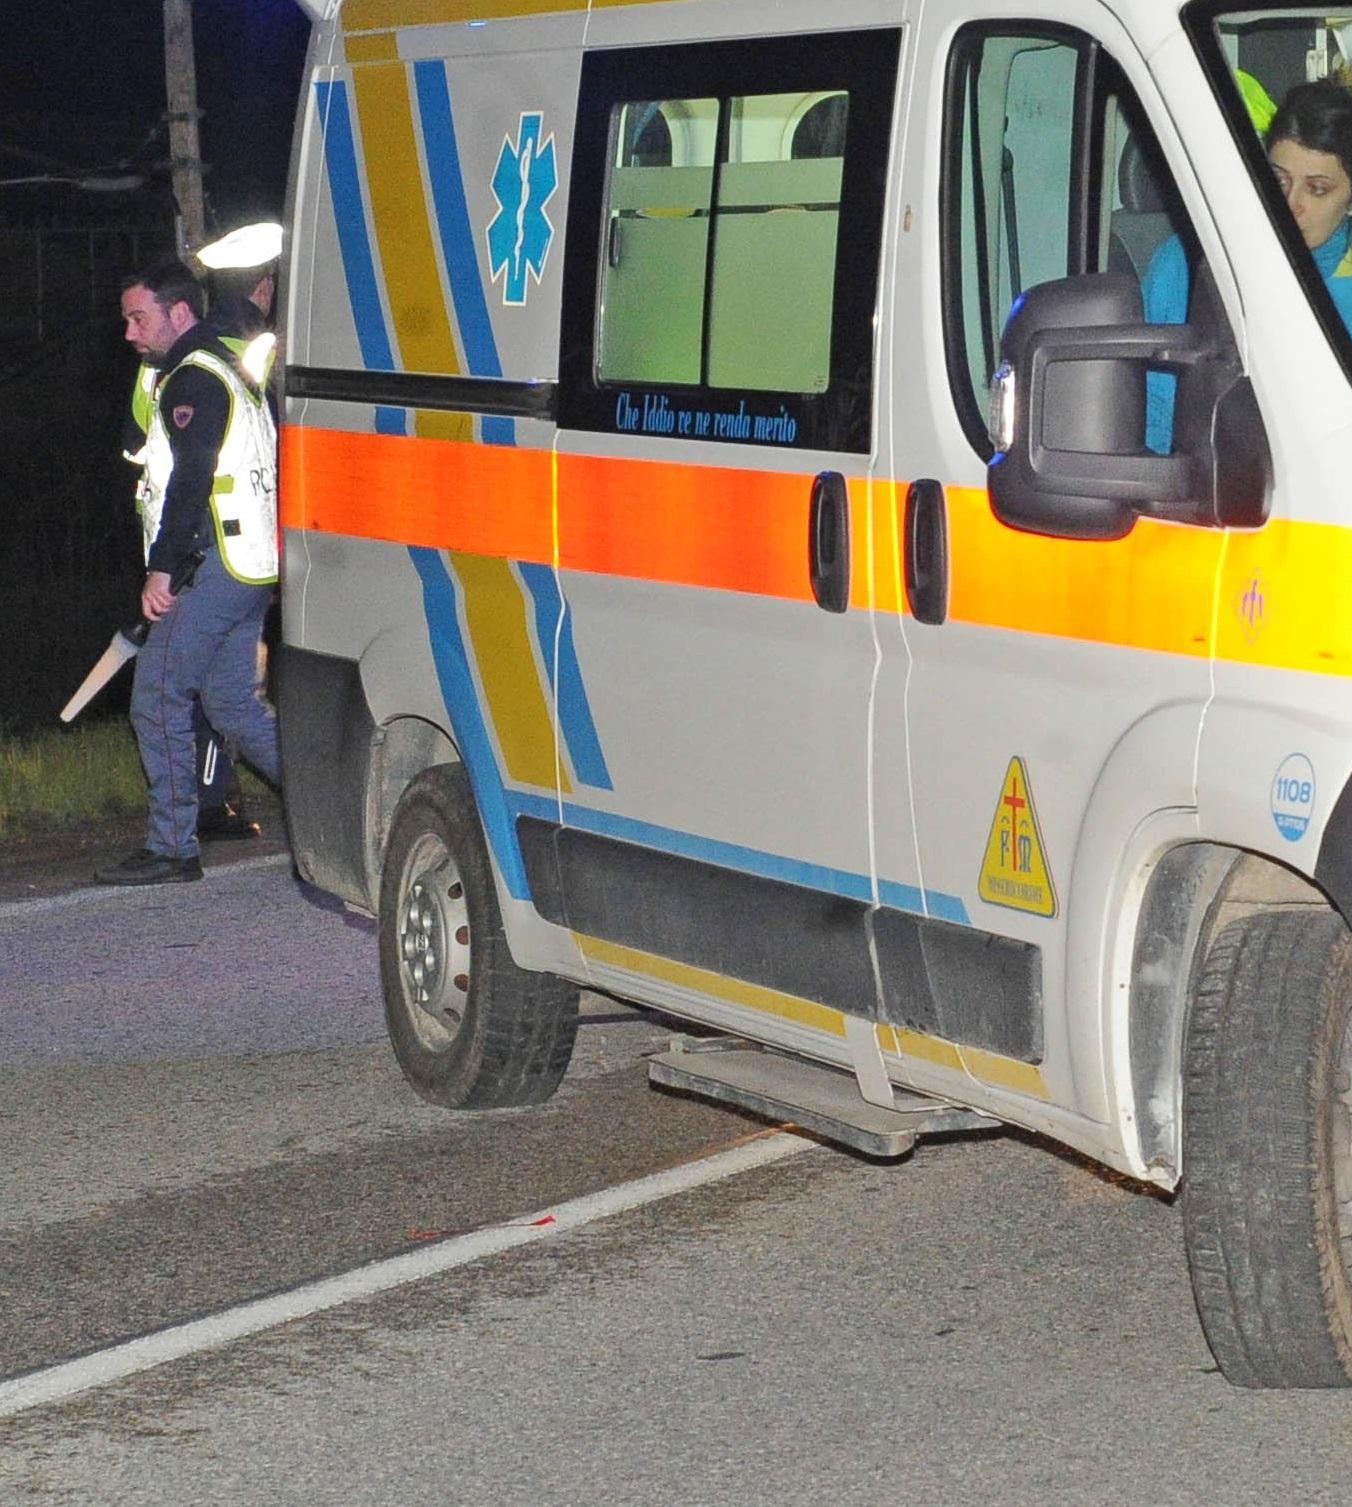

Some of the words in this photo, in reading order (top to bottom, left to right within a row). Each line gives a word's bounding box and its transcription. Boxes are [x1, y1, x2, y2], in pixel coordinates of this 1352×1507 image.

[616, 392, 639, 430] Che
[643, 394, 675, 432] Iddio
[695, 411, 711, 436] ne
[713, 400, 751, 438] renda
[753, 405, 796, 442] merito
[1277, 778, 1311, 803] 1108
